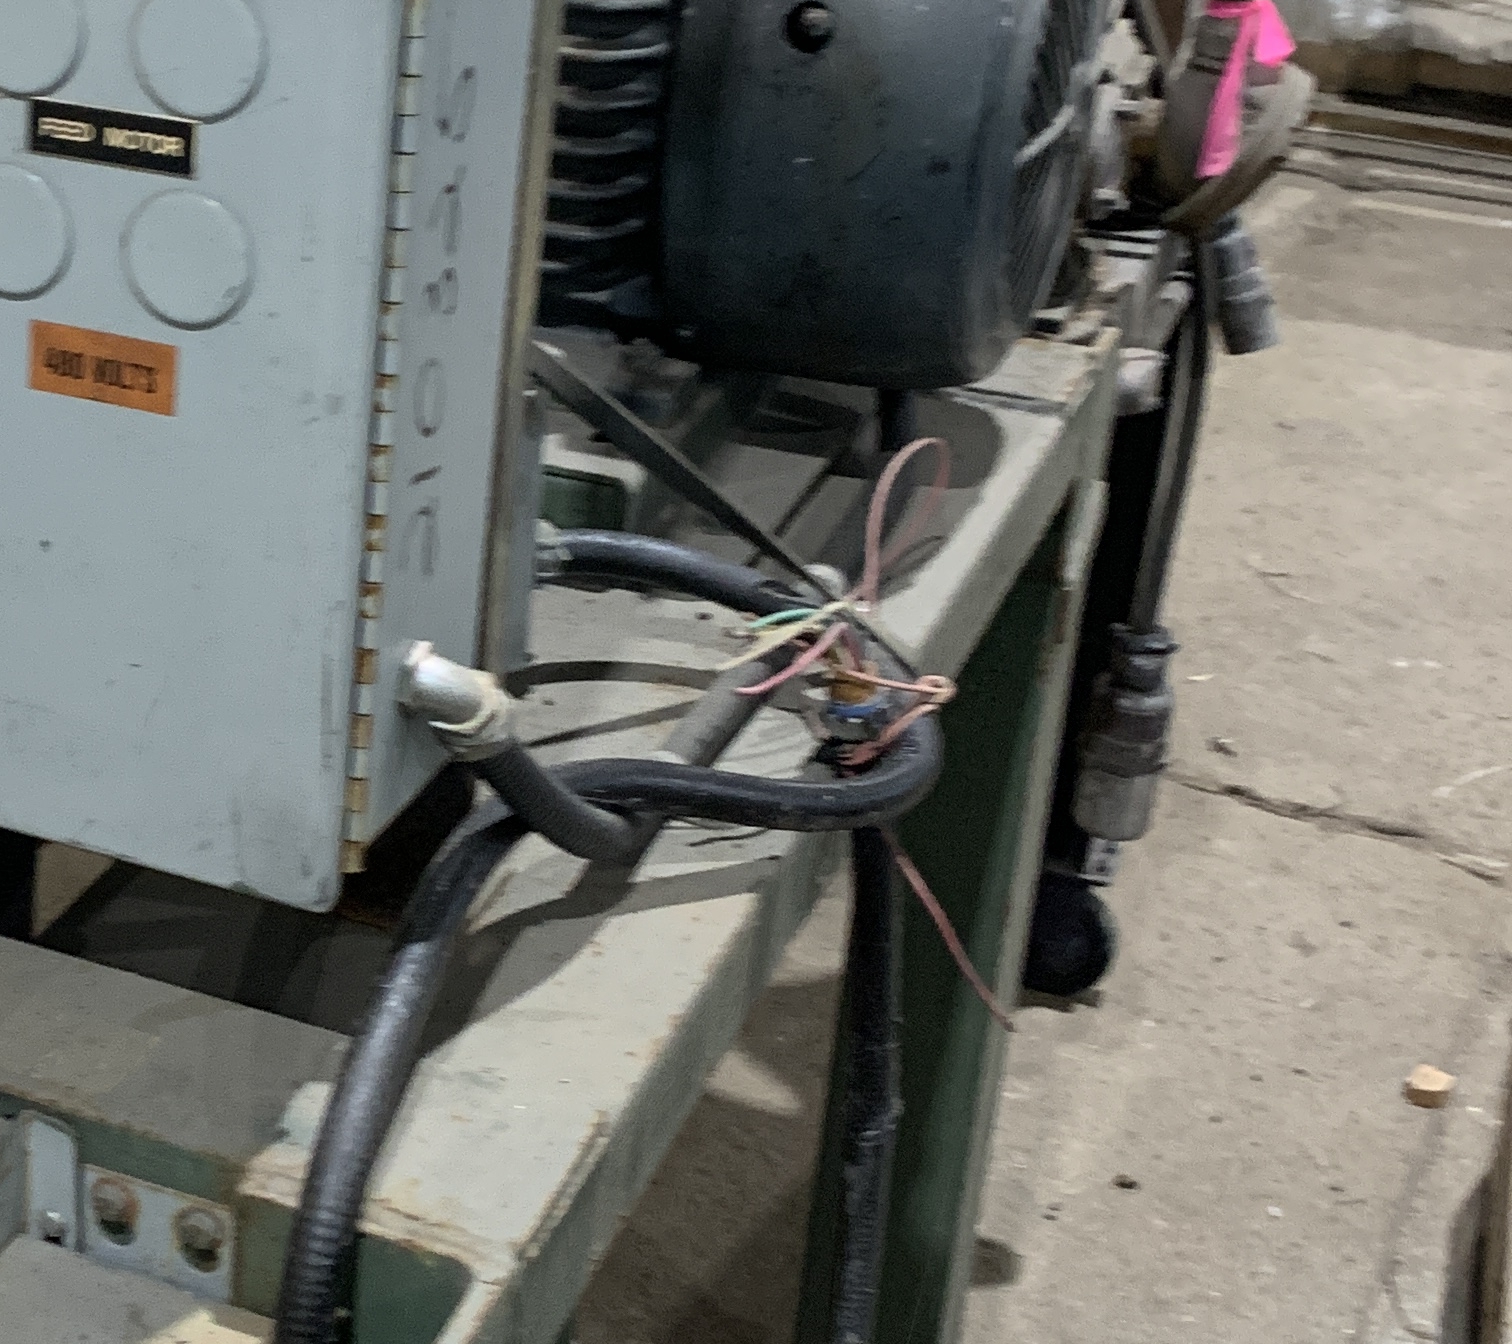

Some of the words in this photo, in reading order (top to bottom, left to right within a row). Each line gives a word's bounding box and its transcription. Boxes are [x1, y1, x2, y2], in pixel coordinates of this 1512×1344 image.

[38, 116, 97, 142] FEED
[102, 126, 185, 157] MOTOR
[93, 357, 158, 394] VOLTS
